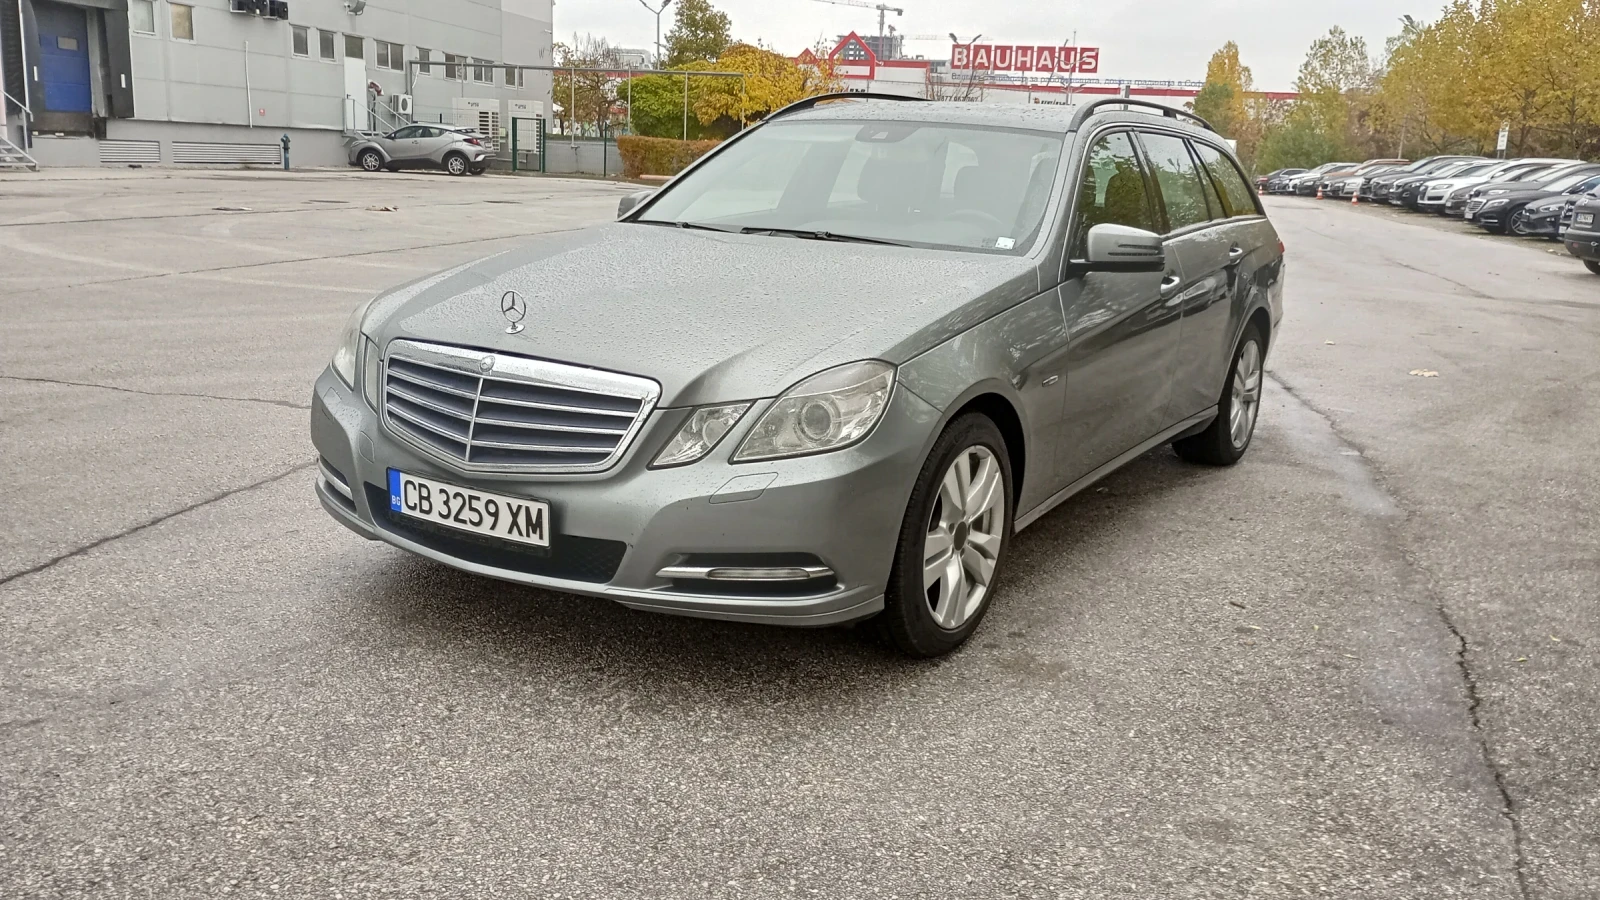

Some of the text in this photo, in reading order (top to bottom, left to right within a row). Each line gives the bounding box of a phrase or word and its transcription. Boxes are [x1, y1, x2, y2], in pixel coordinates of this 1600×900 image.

[952, 46, 1097, 70] BAUHAUS
[391, 495, 401, 506] BG
[403, 479, 544, 541] CB 3259 XM
